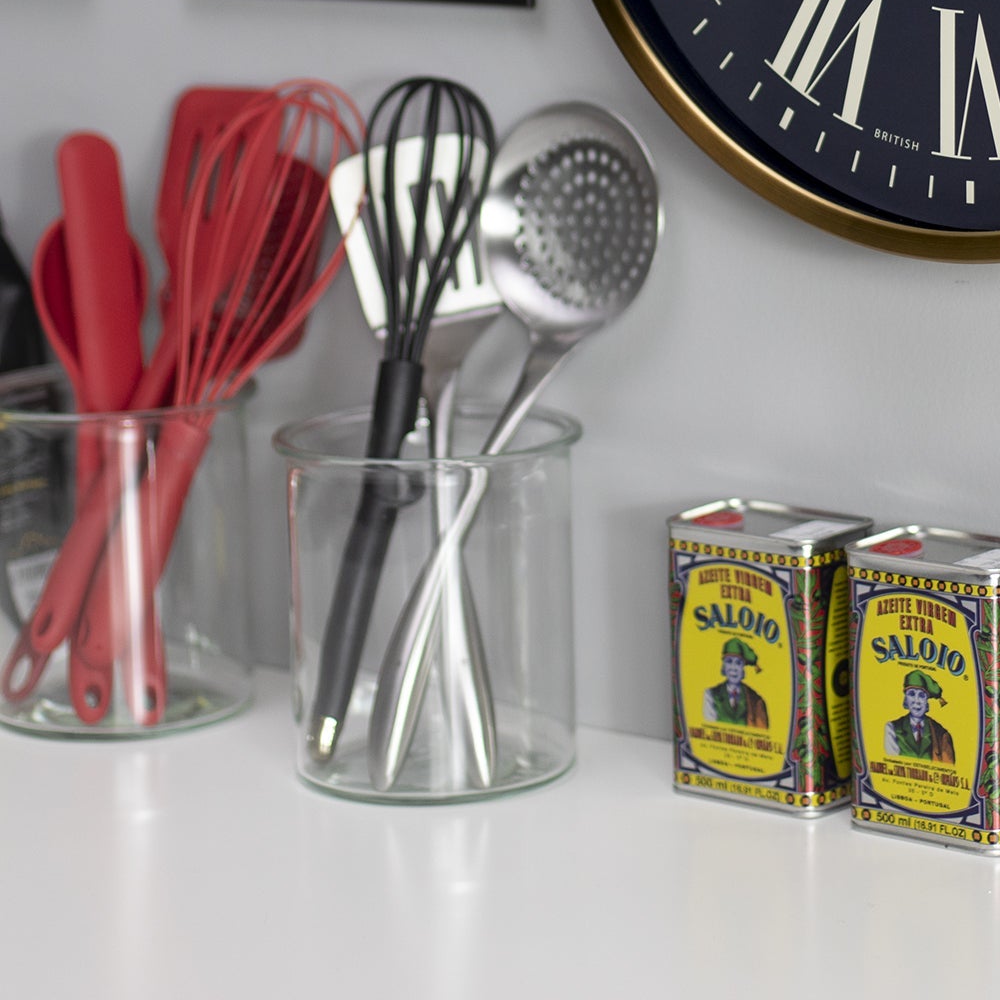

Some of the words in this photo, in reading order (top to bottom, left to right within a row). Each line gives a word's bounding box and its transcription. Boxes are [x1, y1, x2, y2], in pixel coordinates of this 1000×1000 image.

[873, 128, 920, 151] BRITISH
[693, 603, 780, 644] SALOIO
[877, 598, 912, 616] AZEITE
[915, 598, 957, 628] VIRGEM
[900, 614, 934, 635] EXTRA
[871, 634, 965, 676] SALOIO
[876, 811, 896, 824] 500
[898, 816, 911, 827] ml
